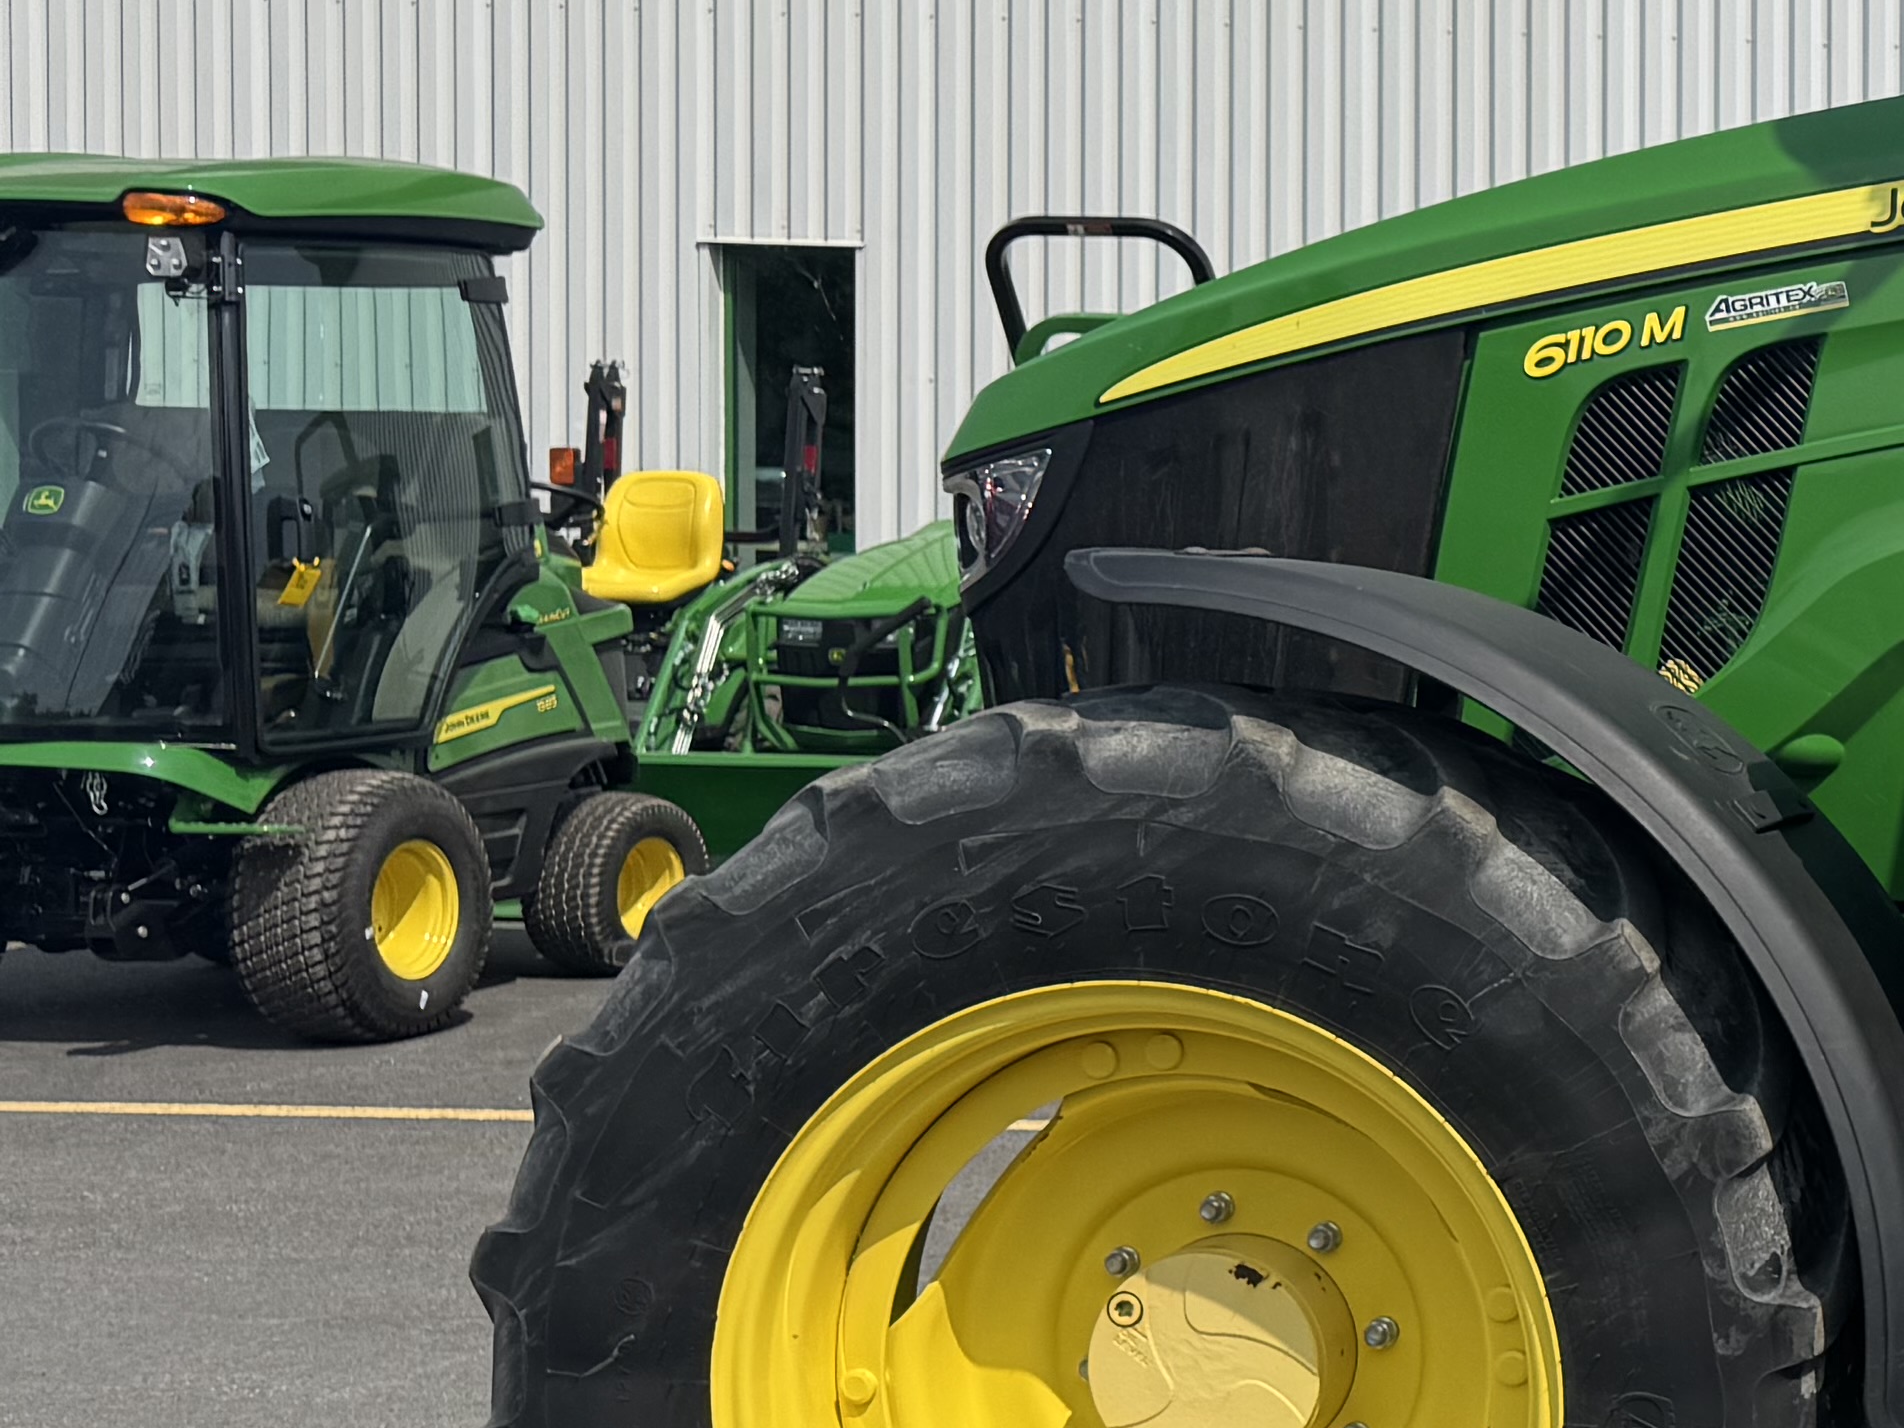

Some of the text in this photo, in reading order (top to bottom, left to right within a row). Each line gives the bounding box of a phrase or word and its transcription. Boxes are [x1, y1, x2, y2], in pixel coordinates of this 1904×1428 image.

[1709, 285, 1815, 318] AGRITEX
[1524, 305, 1686, 378] 6110 M
